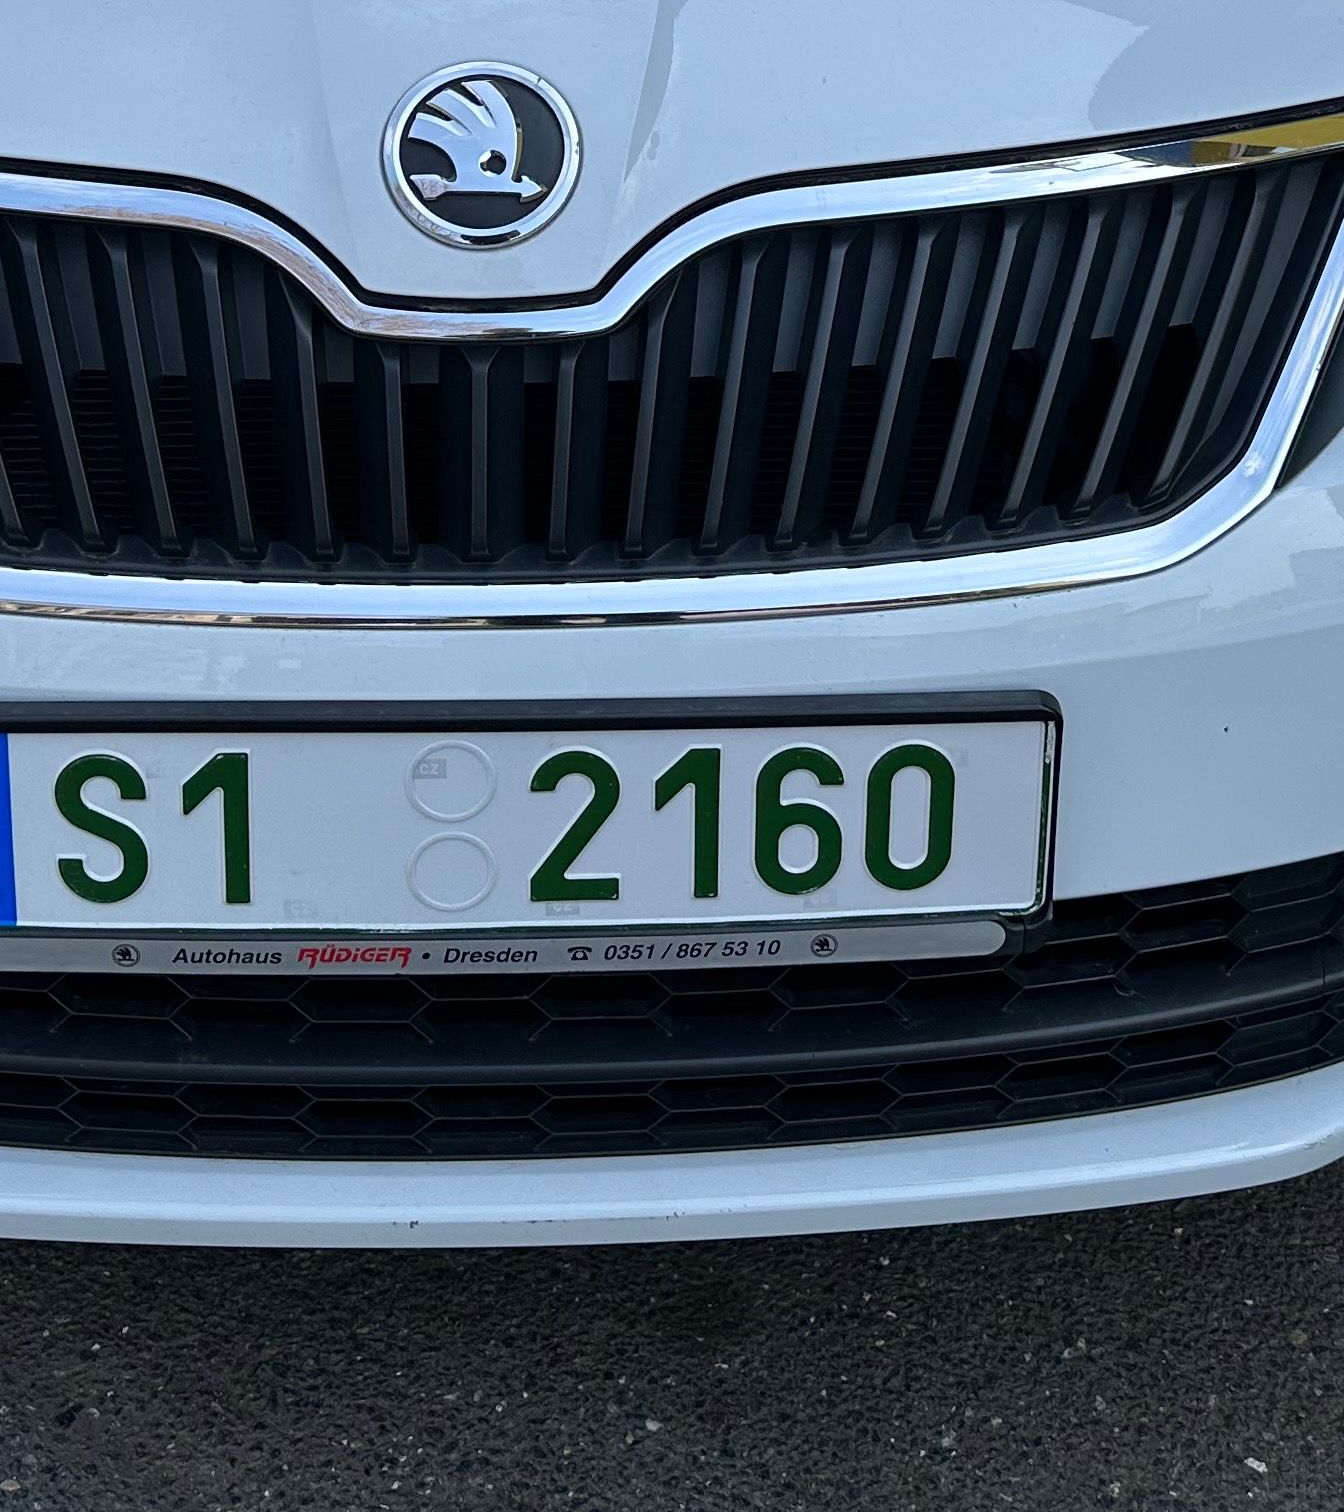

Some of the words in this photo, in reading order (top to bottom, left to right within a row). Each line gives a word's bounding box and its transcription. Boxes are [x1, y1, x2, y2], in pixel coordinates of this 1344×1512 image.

[418, 762, 442, 776] CZ
[53, 751, 252, 905] S1
[529, 743, 956, 903] 2160
[172, 947, 284, 966] Autohaus
[443, 947, 539, 965] Dresden
[603, 944, 656, 962] 0351
[675, 941, 717, 959] 867
[721, 940, 749, 957] 53
[757, 939, 782, 956] 10
